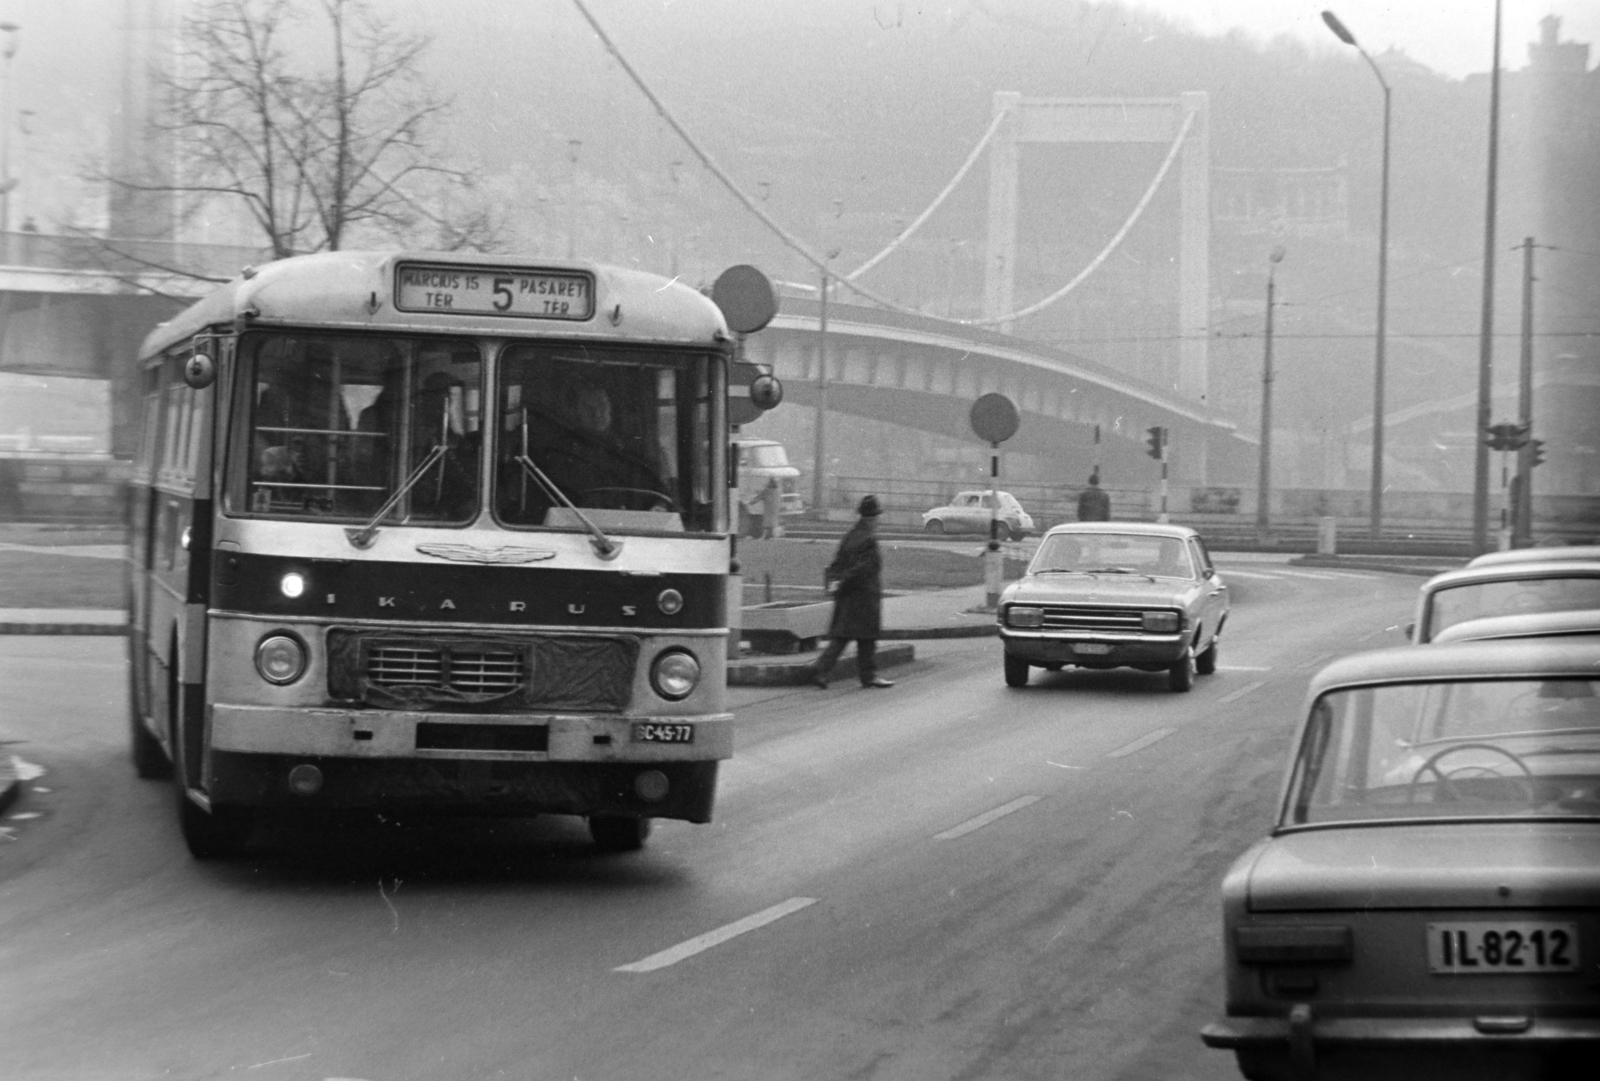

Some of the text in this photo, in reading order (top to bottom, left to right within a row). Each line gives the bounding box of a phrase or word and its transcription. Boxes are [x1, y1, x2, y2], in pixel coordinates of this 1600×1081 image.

[465, 276, 480, 290] 15
[492, 278, 514, 311] 5
[326, 593, 637, 616] IKARUS
